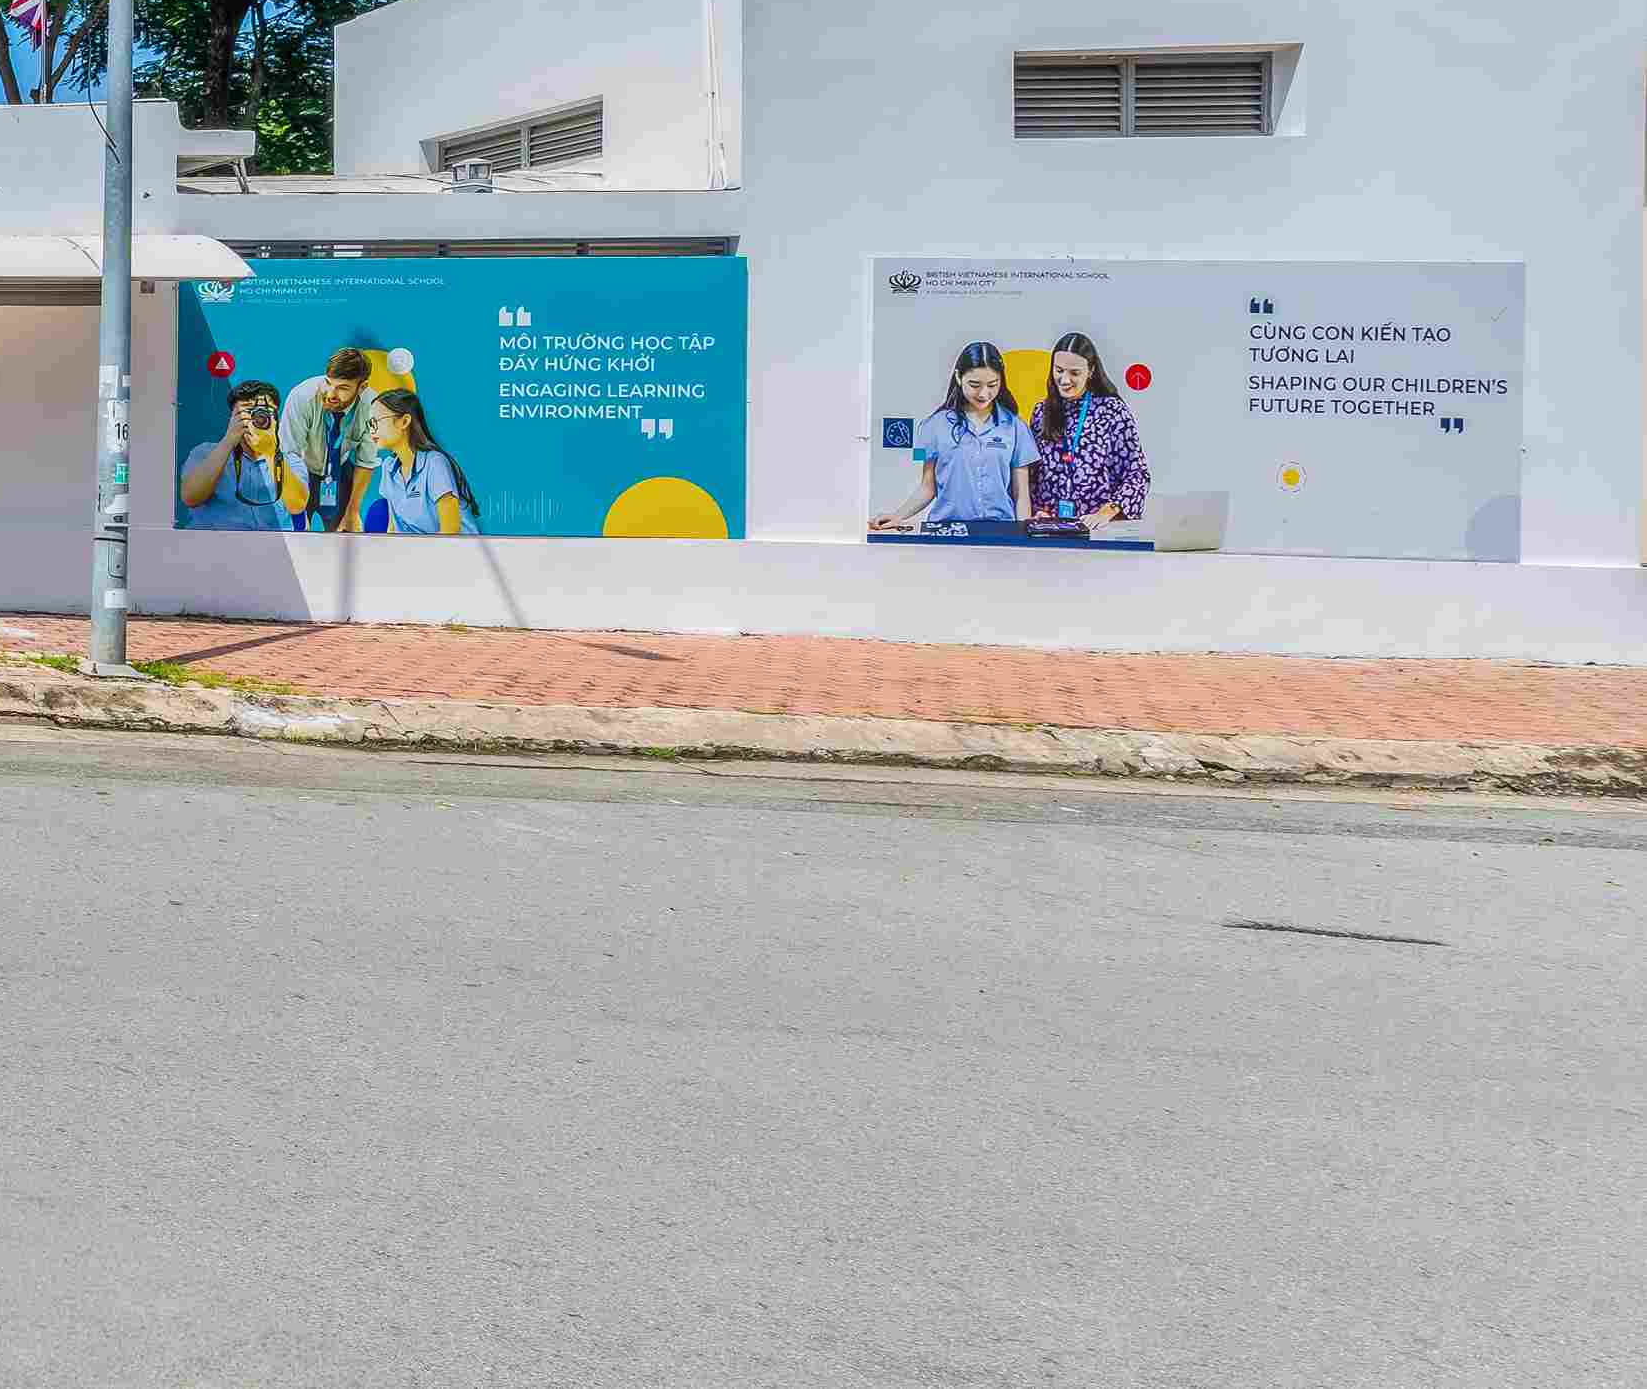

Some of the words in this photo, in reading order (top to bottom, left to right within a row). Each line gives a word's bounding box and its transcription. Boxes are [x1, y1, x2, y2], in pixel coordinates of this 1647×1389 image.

[336, 276, 406, 286] INTERNATIONAL
[408, 277, 444, 286] SCHOOL
[1249, 321, 1306, 340] CÙNG
[1311, 325, 1355, 341] CON
[1360, 322, 1406, 342] KIẾN
[1411, 327, 1451, 346] TẠO
[500, 333, 537, 350] MÔI
[543, 333, 624, 351] TRƯỜNG
[631, 336, 673, 354] HỌC
[678, 333, 715, 354] TẬP
[545, 354, 601, 371] HỨNG
[1249, 346, 1319, 363] TƯƠNG
[1326, 349, 1355, 363] LAI
[499, 383, 601, 398] ENGAGING
[607, 384, 705, 398] LEARNING
[1248, 375, 1336, 391] SHAPING
[1343, 377, 1385, 392] OUR
[1391, 378, 1508, 394] CHILDREN'S
[499, 405, 643, 419] ENVIRONMENT
[1249, 398, 1325, 413] FUTURE
[1331, 399, 1435, 416] TOGETHER
